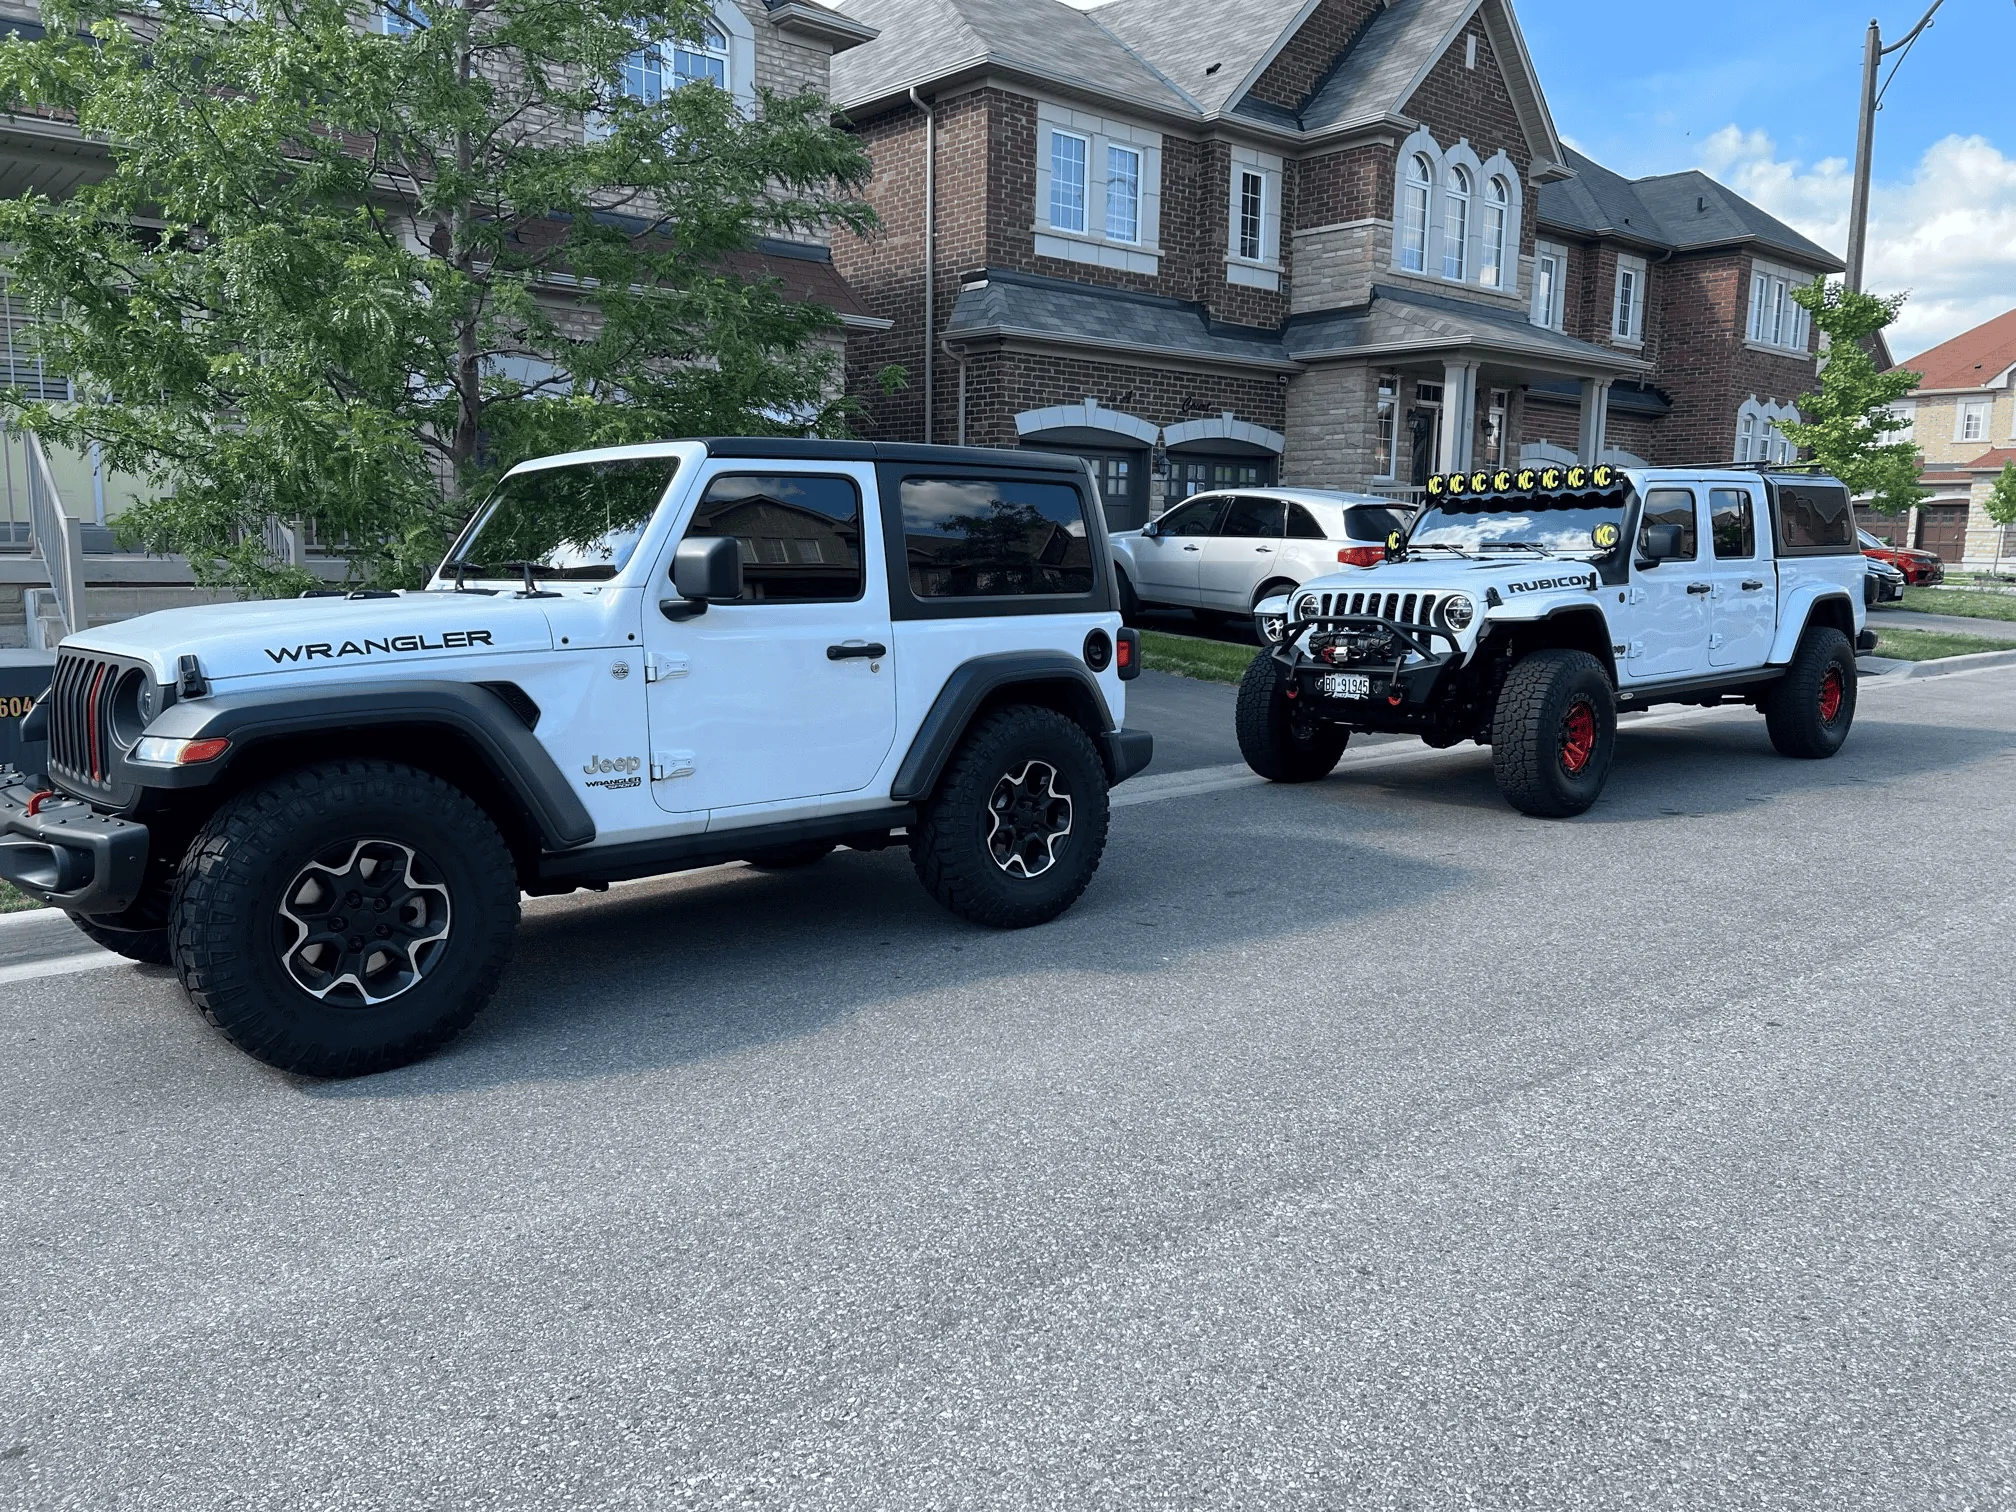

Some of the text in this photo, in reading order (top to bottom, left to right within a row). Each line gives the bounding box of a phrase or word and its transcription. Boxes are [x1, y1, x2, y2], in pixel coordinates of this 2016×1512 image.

[1428, 476, 1442, 495] KC
[1450, 475, 1464, 493] KC
[1471, 473, 1486, 492] KC
[1494, 472, 1510, 491] KC
[1518, 470, 1534, 490] KC
[1542, 469, 1558, 488] KC
[1567, 467, 1584, 487] KC
[1594, 466, 1611, 486] KC
[1387, 531, 1400, 550] KC
[1596, 525, 1615, 546] KC
[1507, 575, 1592, 594] RUBICON
[264, 630, 494, 664] WRANGLER
[583, 754, 641, 775] Jeep
[585, 776, 641, 787] WRANGLER
